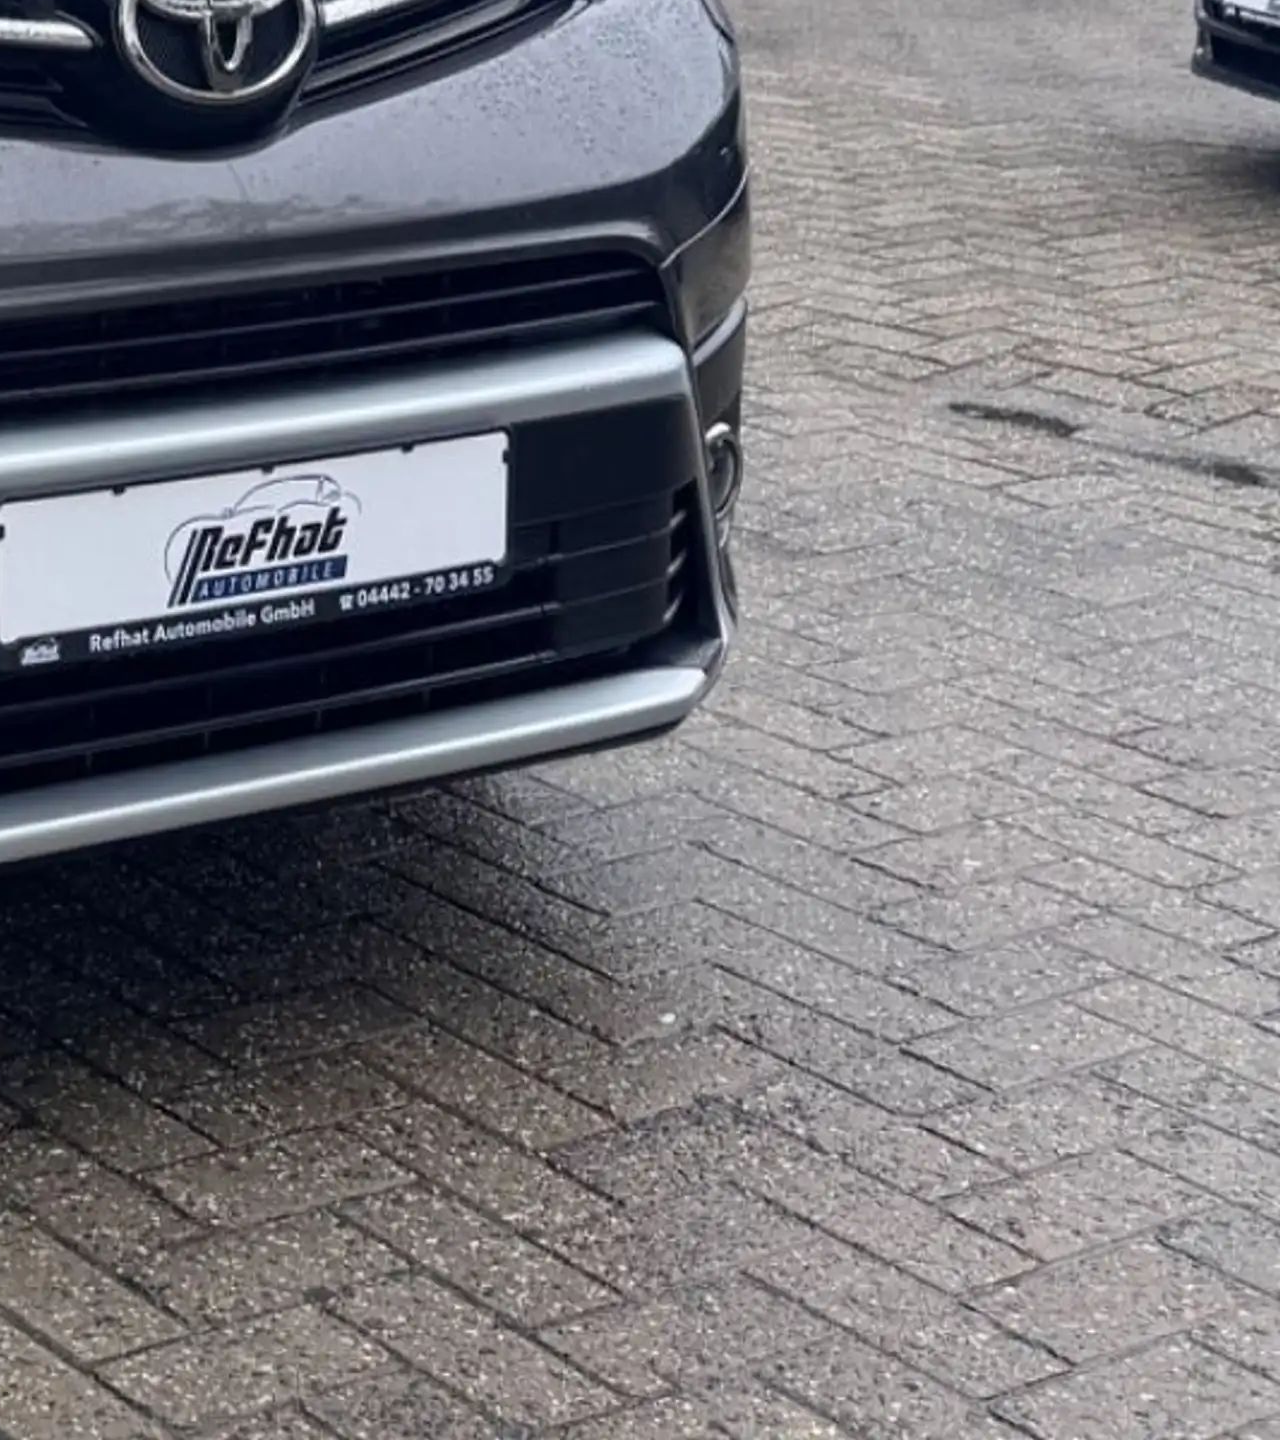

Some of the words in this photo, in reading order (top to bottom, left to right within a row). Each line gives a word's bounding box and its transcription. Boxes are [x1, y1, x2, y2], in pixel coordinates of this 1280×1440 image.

[88, 627, 149, 652] Refhat
[153, 606, 257, 642] Automobile
[261, 598, 316, 624] GmbH
[357, 581, 411, 608] 04442
[424, 575, 446, 596] 70
[449, 571, 469, 591] 34
[473, 565, 494, 587] 55
[199, 561, 333, 598] AUTOMOBILE
